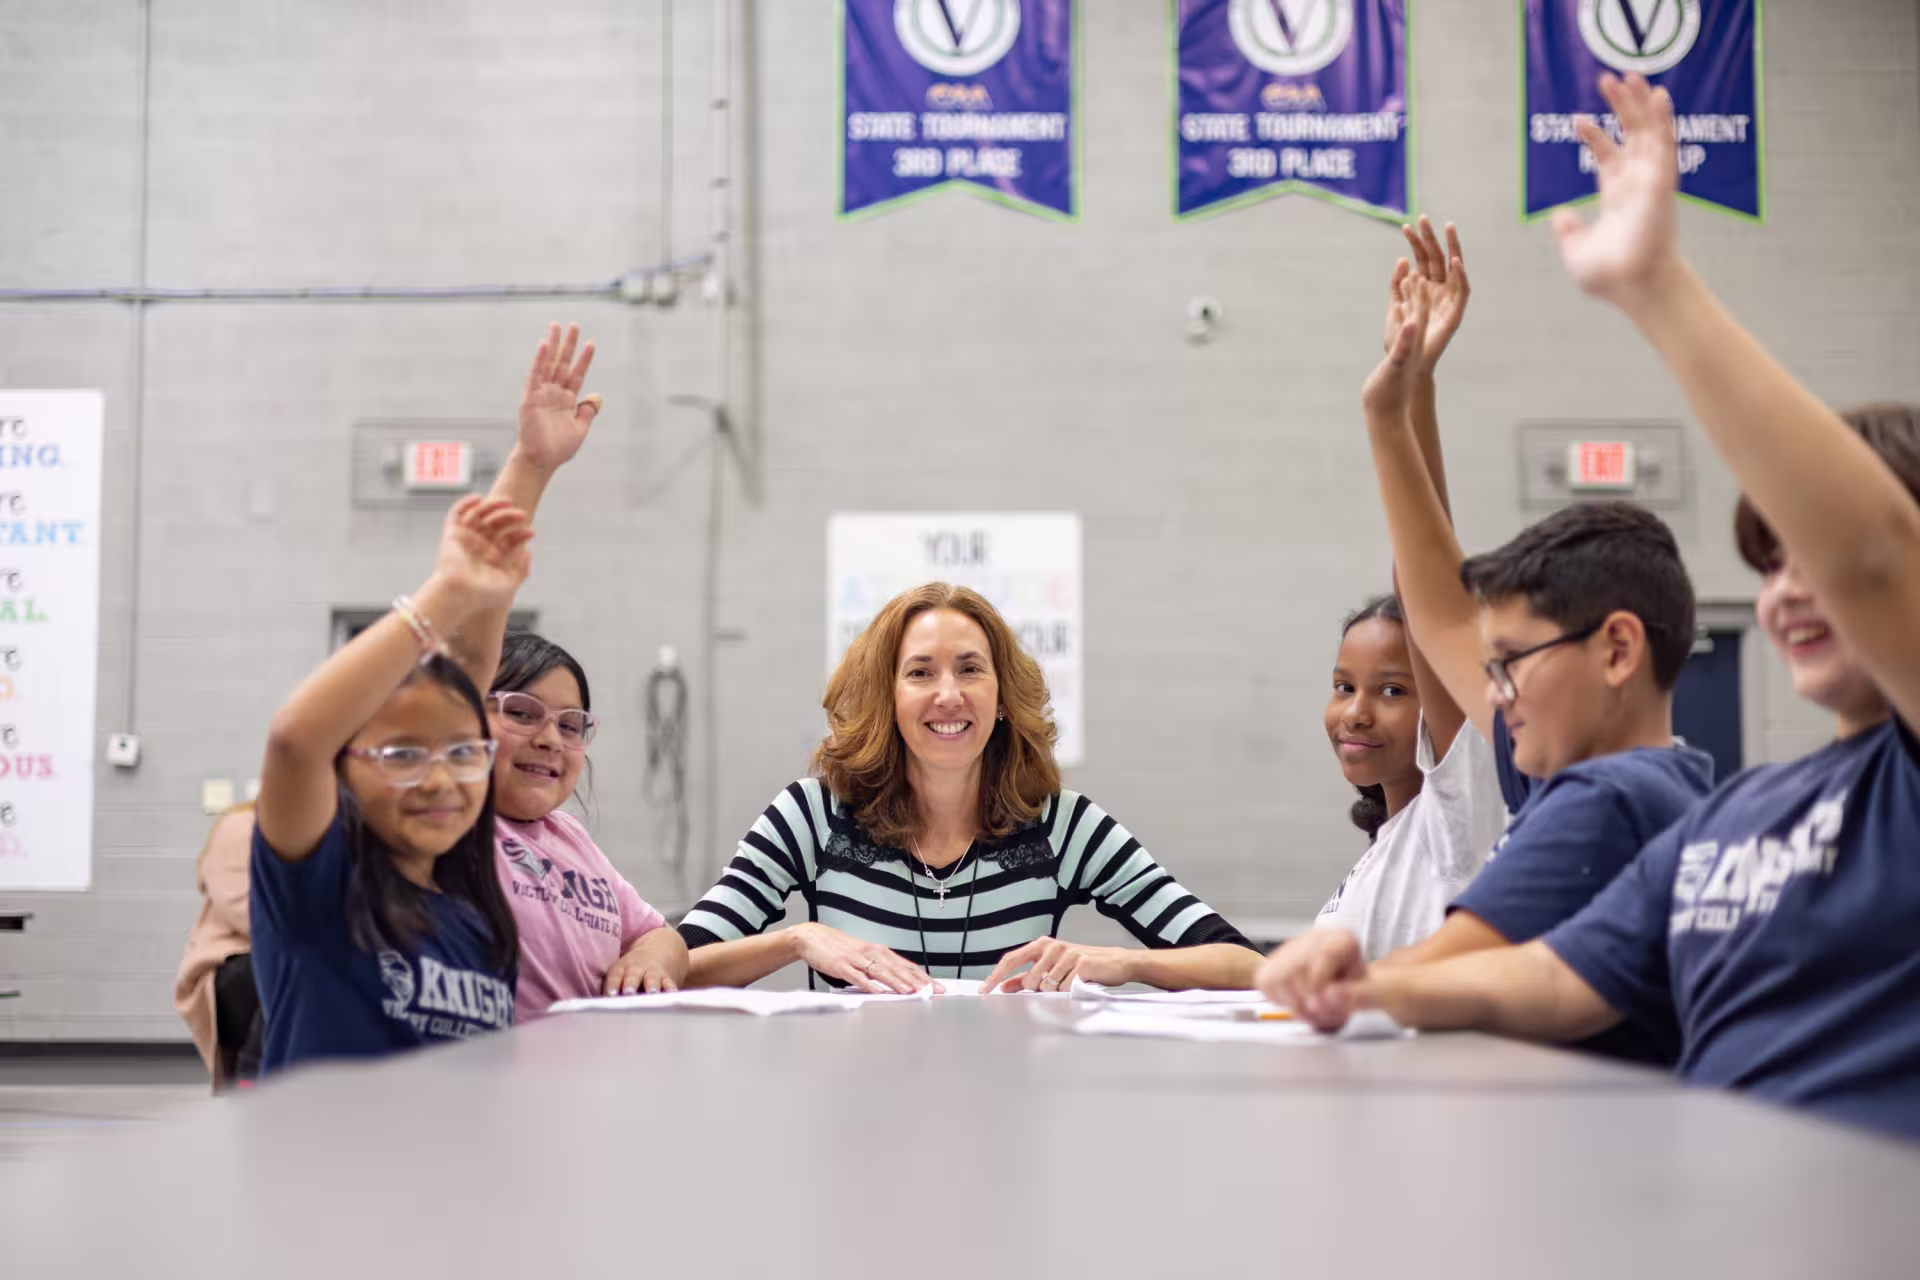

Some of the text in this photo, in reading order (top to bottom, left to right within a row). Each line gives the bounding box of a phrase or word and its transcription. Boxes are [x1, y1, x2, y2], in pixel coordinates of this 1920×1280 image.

[847, 111, 1067, 141] STATE TOURNAMENT
[1181, 112, 1400, 142] STATE TOURNAMENT
[1600, 113, 1750, 143] TAMENT
[892, 147, 1022, 177] 3RD PLACE
[1227, 147, 1356, 179] 3RD PLACE
[416, 443, 463, 481] EXIT
[1580, 442, 1626, 482] EXIT
[920, 528, 992, 568] YOUR
